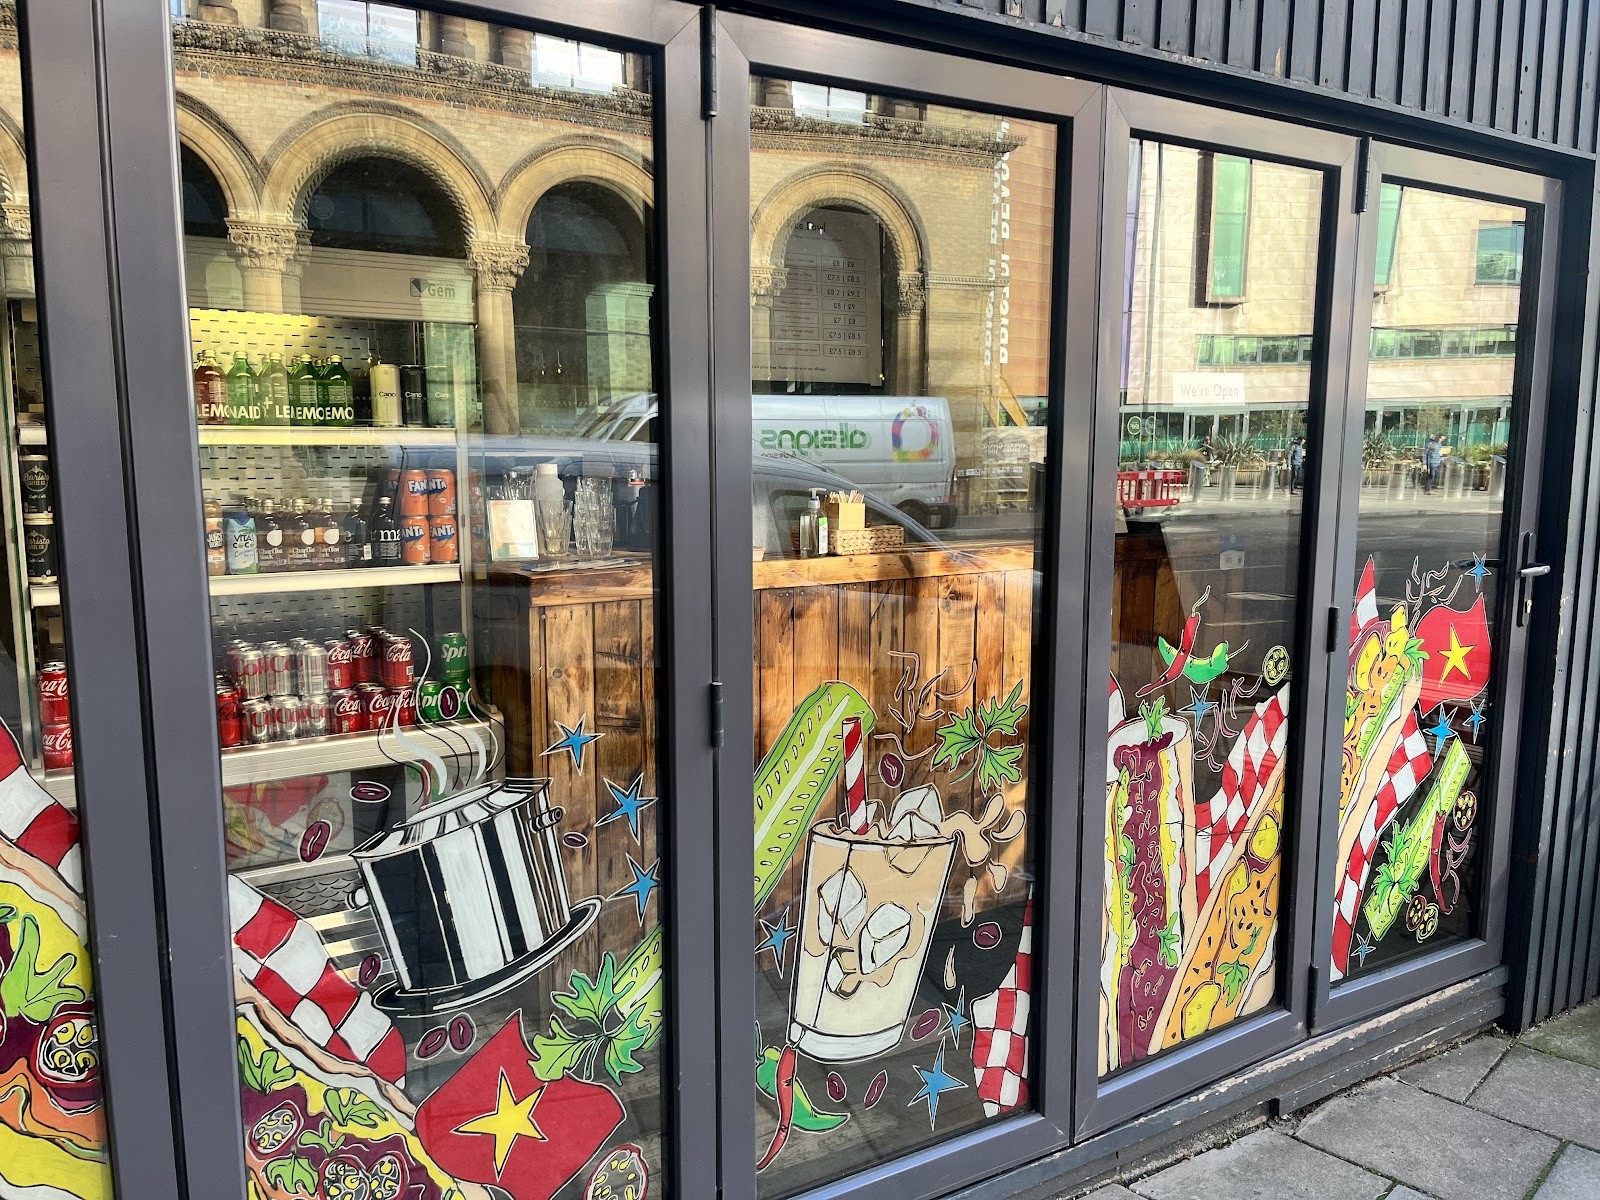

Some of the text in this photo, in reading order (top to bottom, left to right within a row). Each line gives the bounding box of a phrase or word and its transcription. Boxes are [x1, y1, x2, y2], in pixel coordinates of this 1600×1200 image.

[427, 284, 456, 298] Gem
[1180, 383, 1239, 398] We're Open
